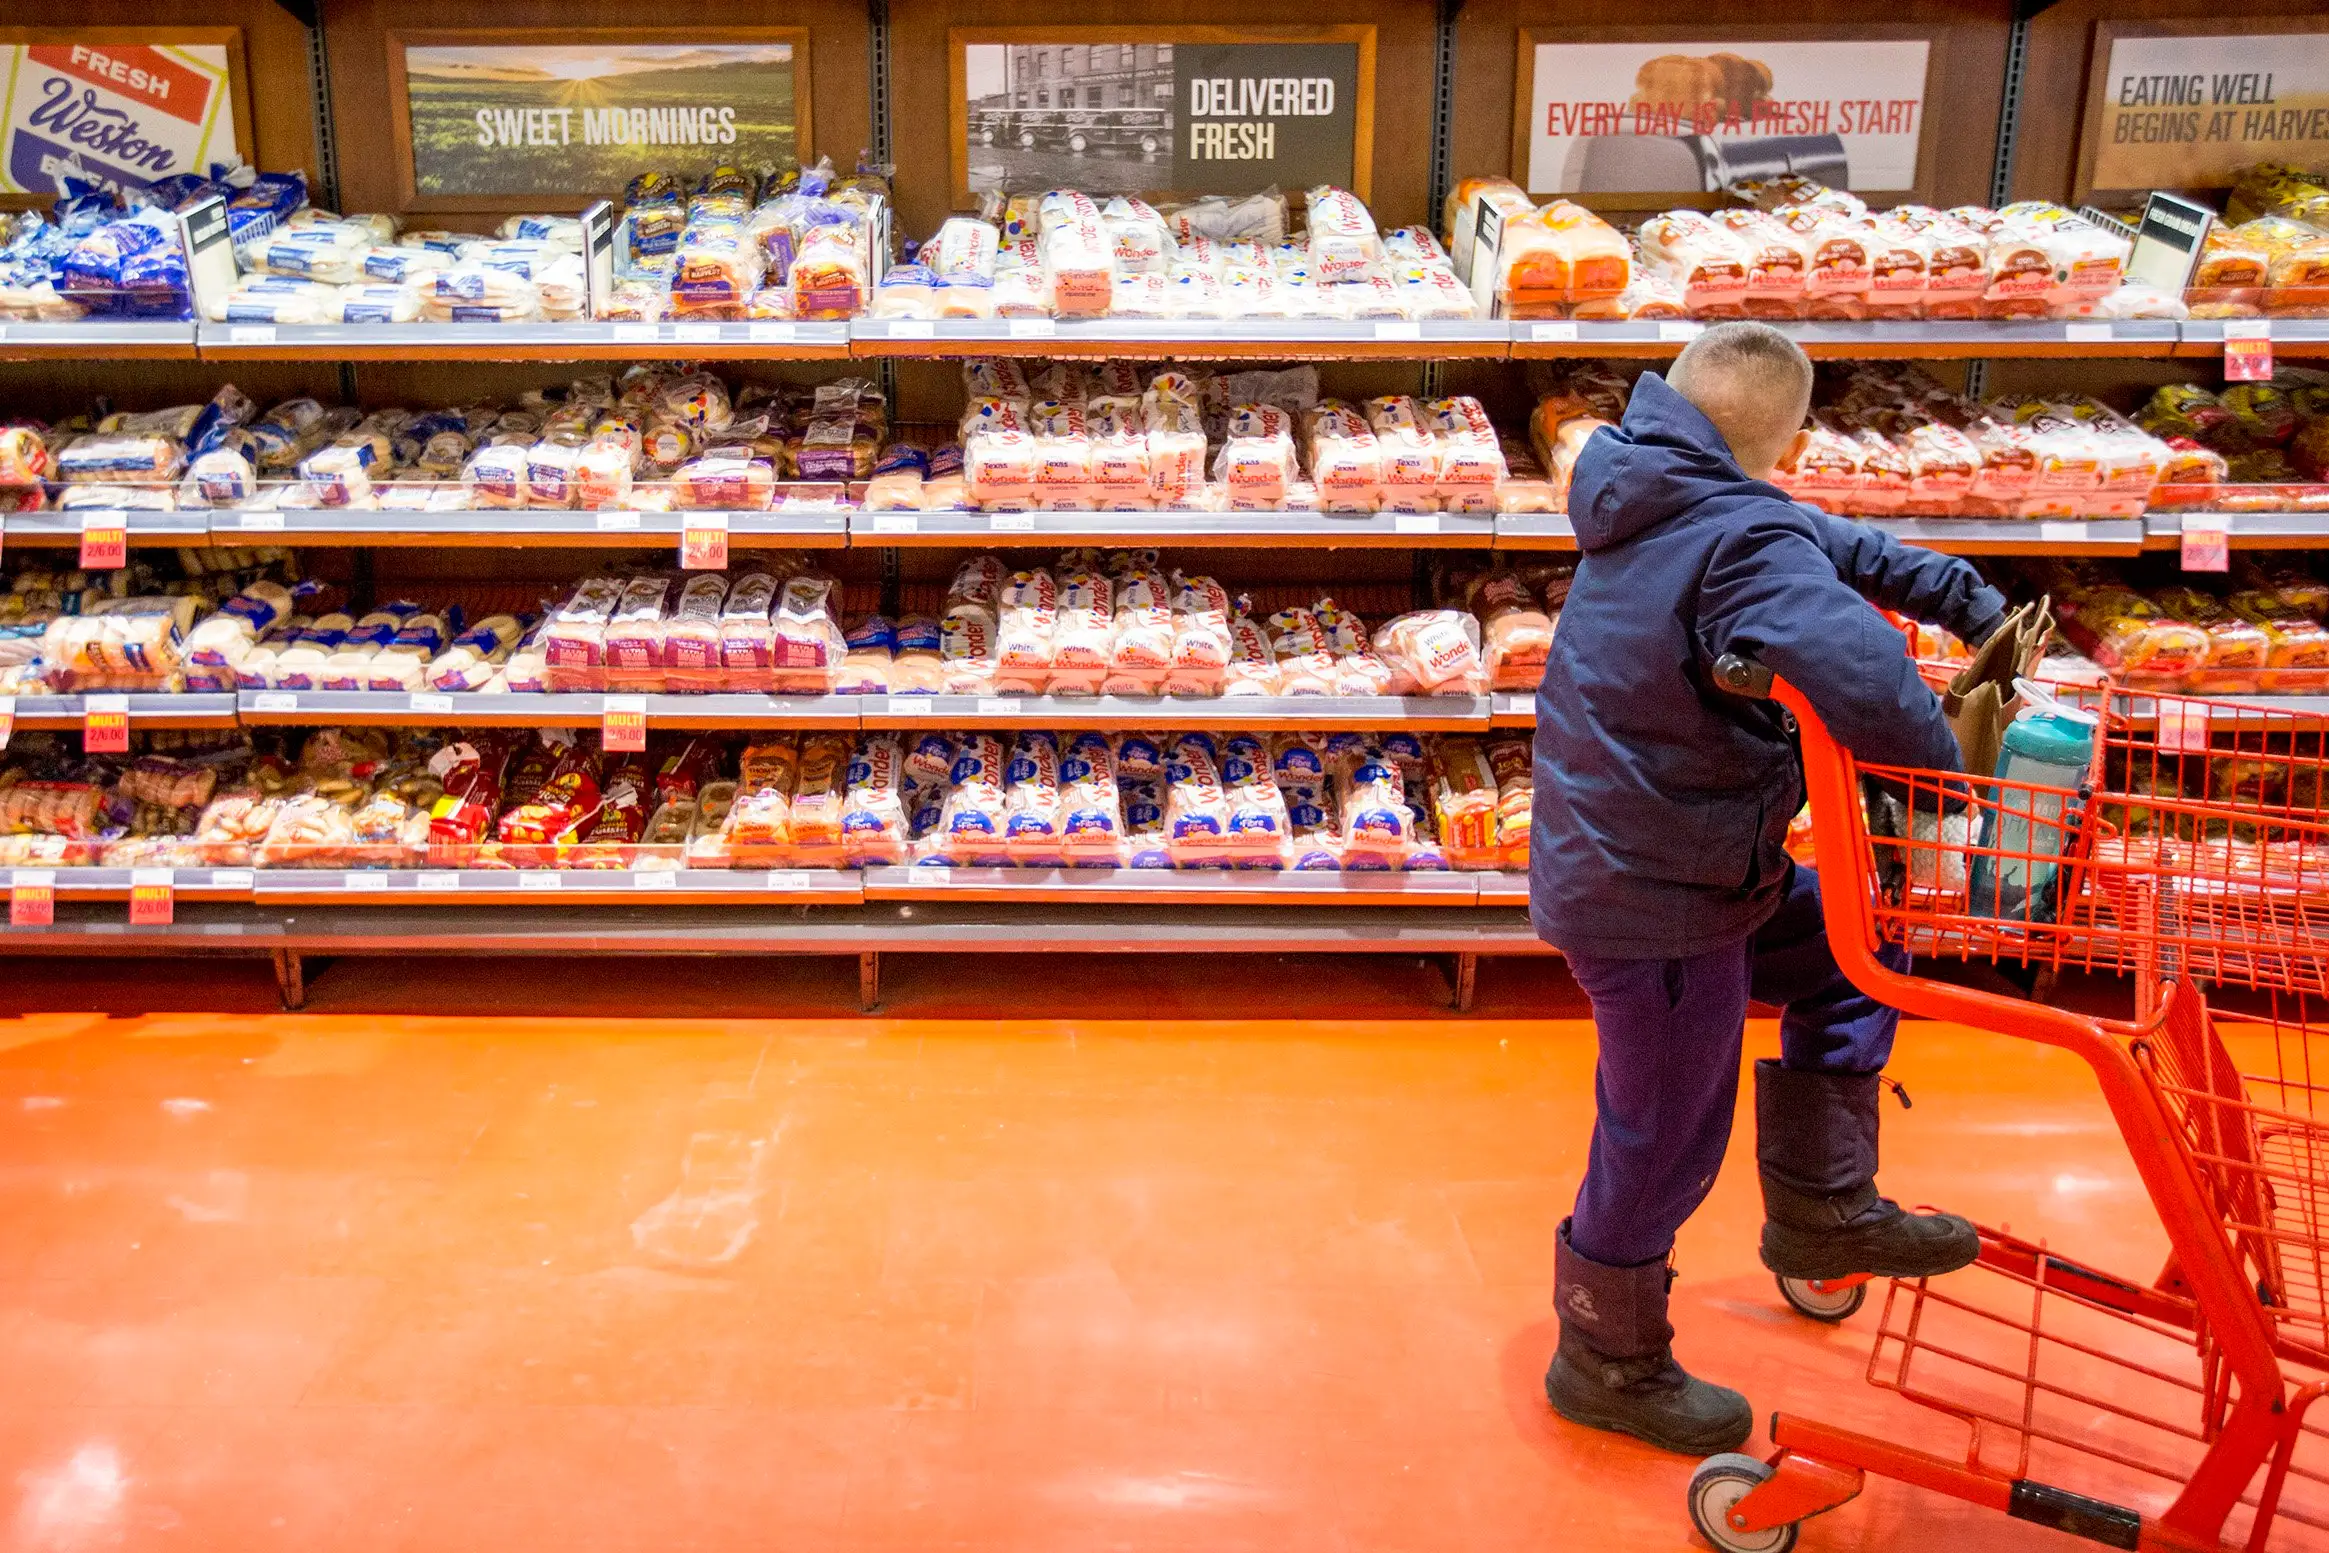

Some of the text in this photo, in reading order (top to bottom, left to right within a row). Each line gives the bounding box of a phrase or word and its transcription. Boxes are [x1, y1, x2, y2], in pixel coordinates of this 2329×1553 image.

[70, 45, 170, 99] FRESH
[1190, 78, 1335, 117] DELIVERED
[2119, 73, 2275, 107] EATING WELL
[29, 77, 176, 172] Weston
[476, 107, 737, 146] SWEET MORNINGS
[1547, 100, 1918, 136] EVERY DAY IS A FRESH START
[2113, 111, 2198, 144] BEGINS
[2204, 111, 2237, 142] AT
[1190, 123, 1275, 160] FRESH
[85, 531, 123, 542] MULTI
[88, 715, 125, 727] MULTI
[607, 714, 643, 727] MULTI
[2019, 798, 2062, 819] SMAR
